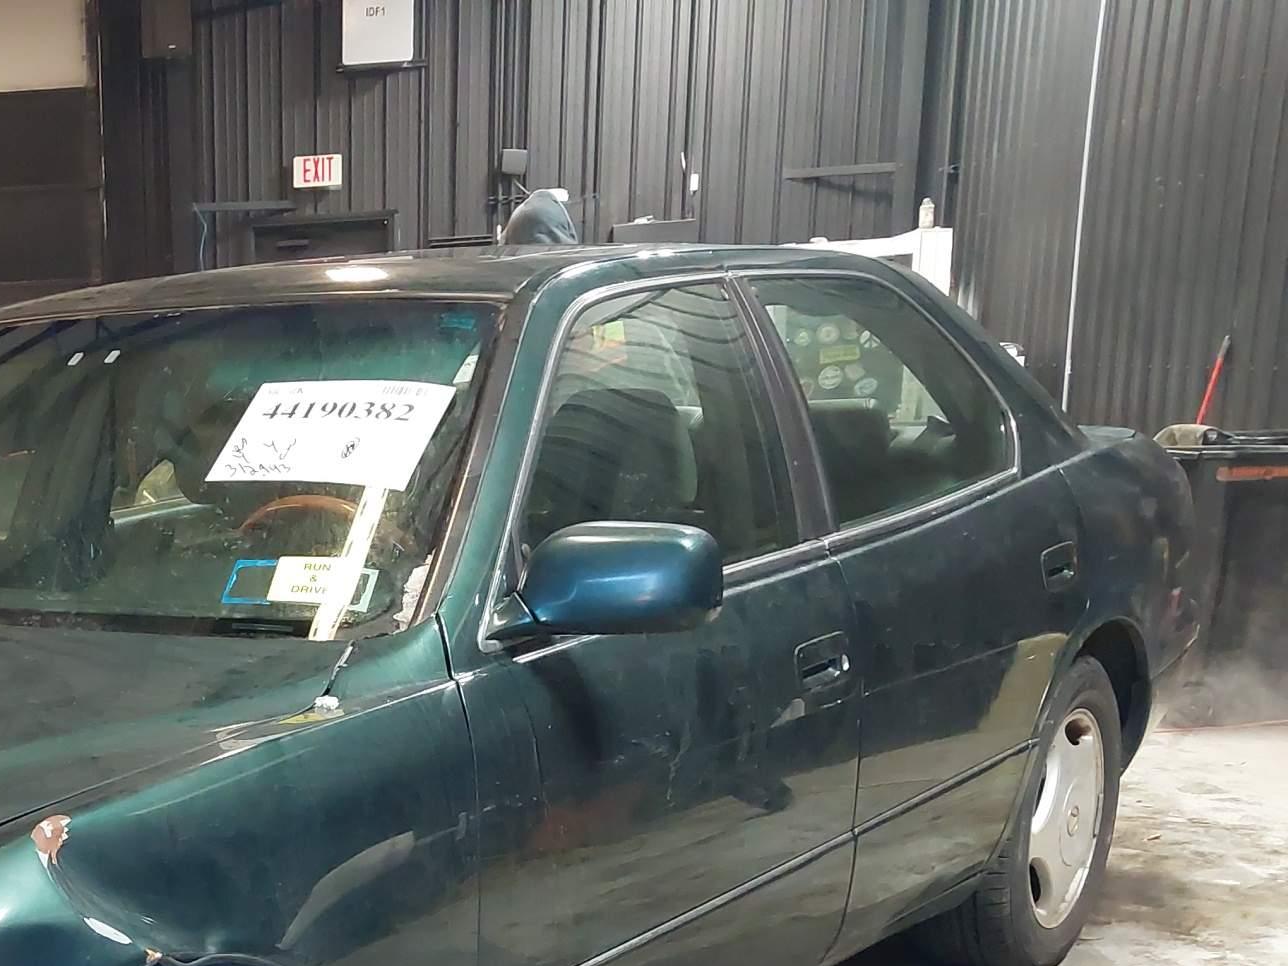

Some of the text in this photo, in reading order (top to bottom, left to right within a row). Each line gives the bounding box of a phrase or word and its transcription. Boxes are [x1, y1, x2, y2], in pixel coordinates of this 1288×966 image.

[365, 7, 386, 17] IDF1
[303, 156, 334, 183] EXIT
[262, 402, 415, 421] 44190382
[303, 563, 332, 571] RUN
[309, 574, 317, 582] &
